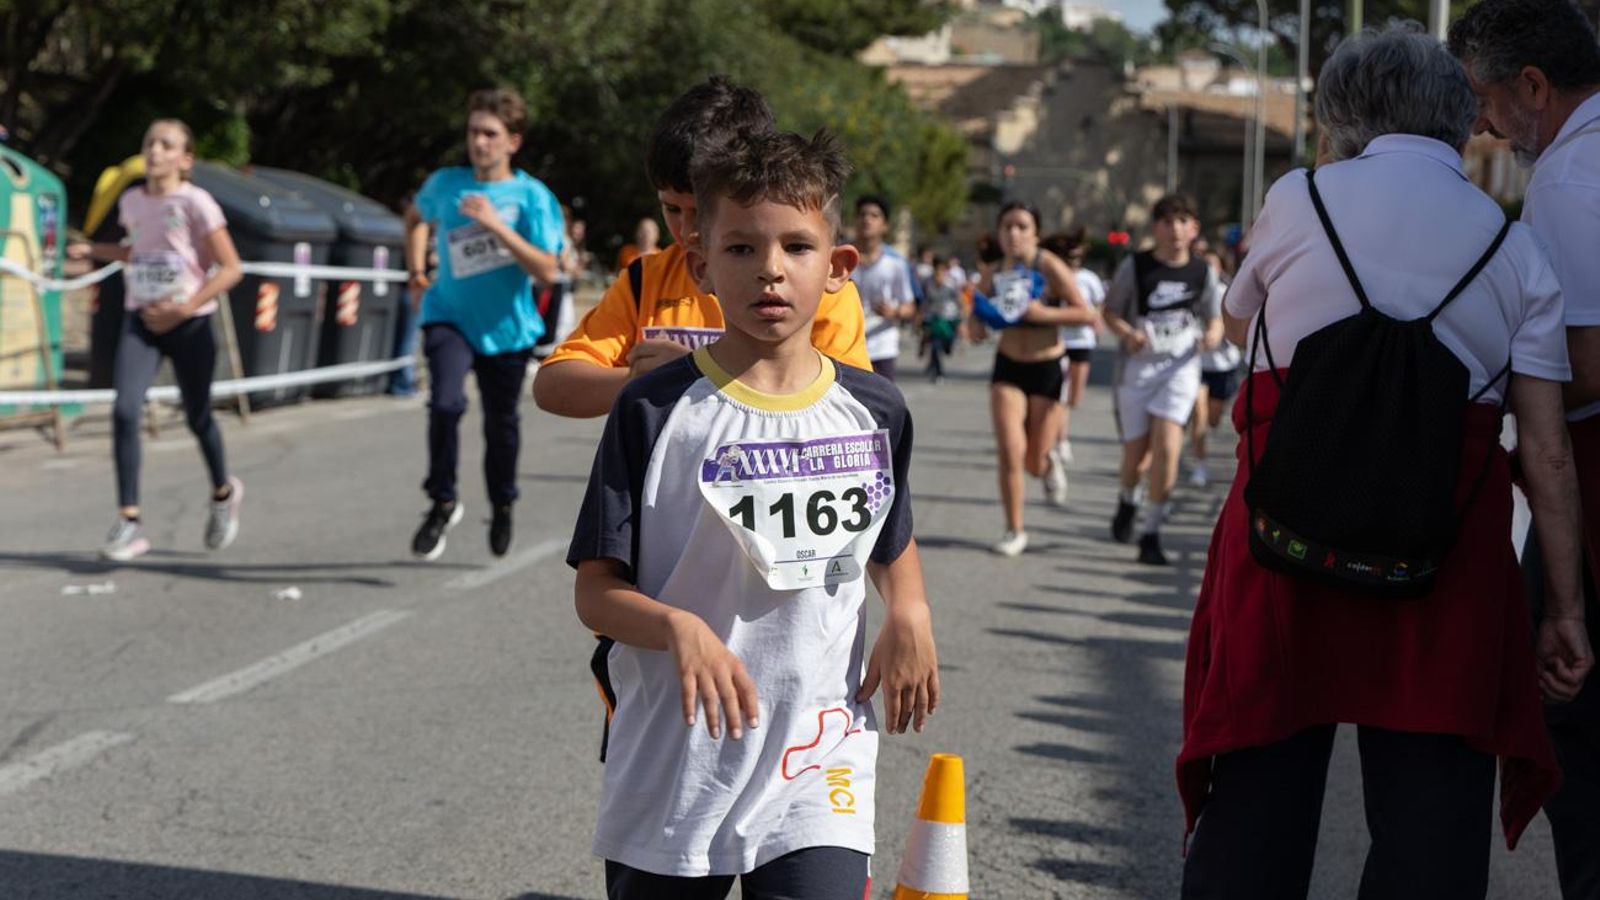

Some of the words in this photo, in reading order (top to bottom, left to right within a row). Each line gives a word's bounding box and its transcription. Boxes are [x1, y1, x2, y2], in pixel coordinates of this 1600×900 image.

[737, 448, 799, 475] XXXVI
[801, 442, 843, 458] CARRERA
[845, 439, 881, 453] ESCOLAR
[809, 457, 825, 472] LA
[833, 453, 871, 469] GLORIA
[729, 487, 871, 538] 1163
[796, 549, 816, 559] OSCAR
[826, 768, 856, 813] MCI
